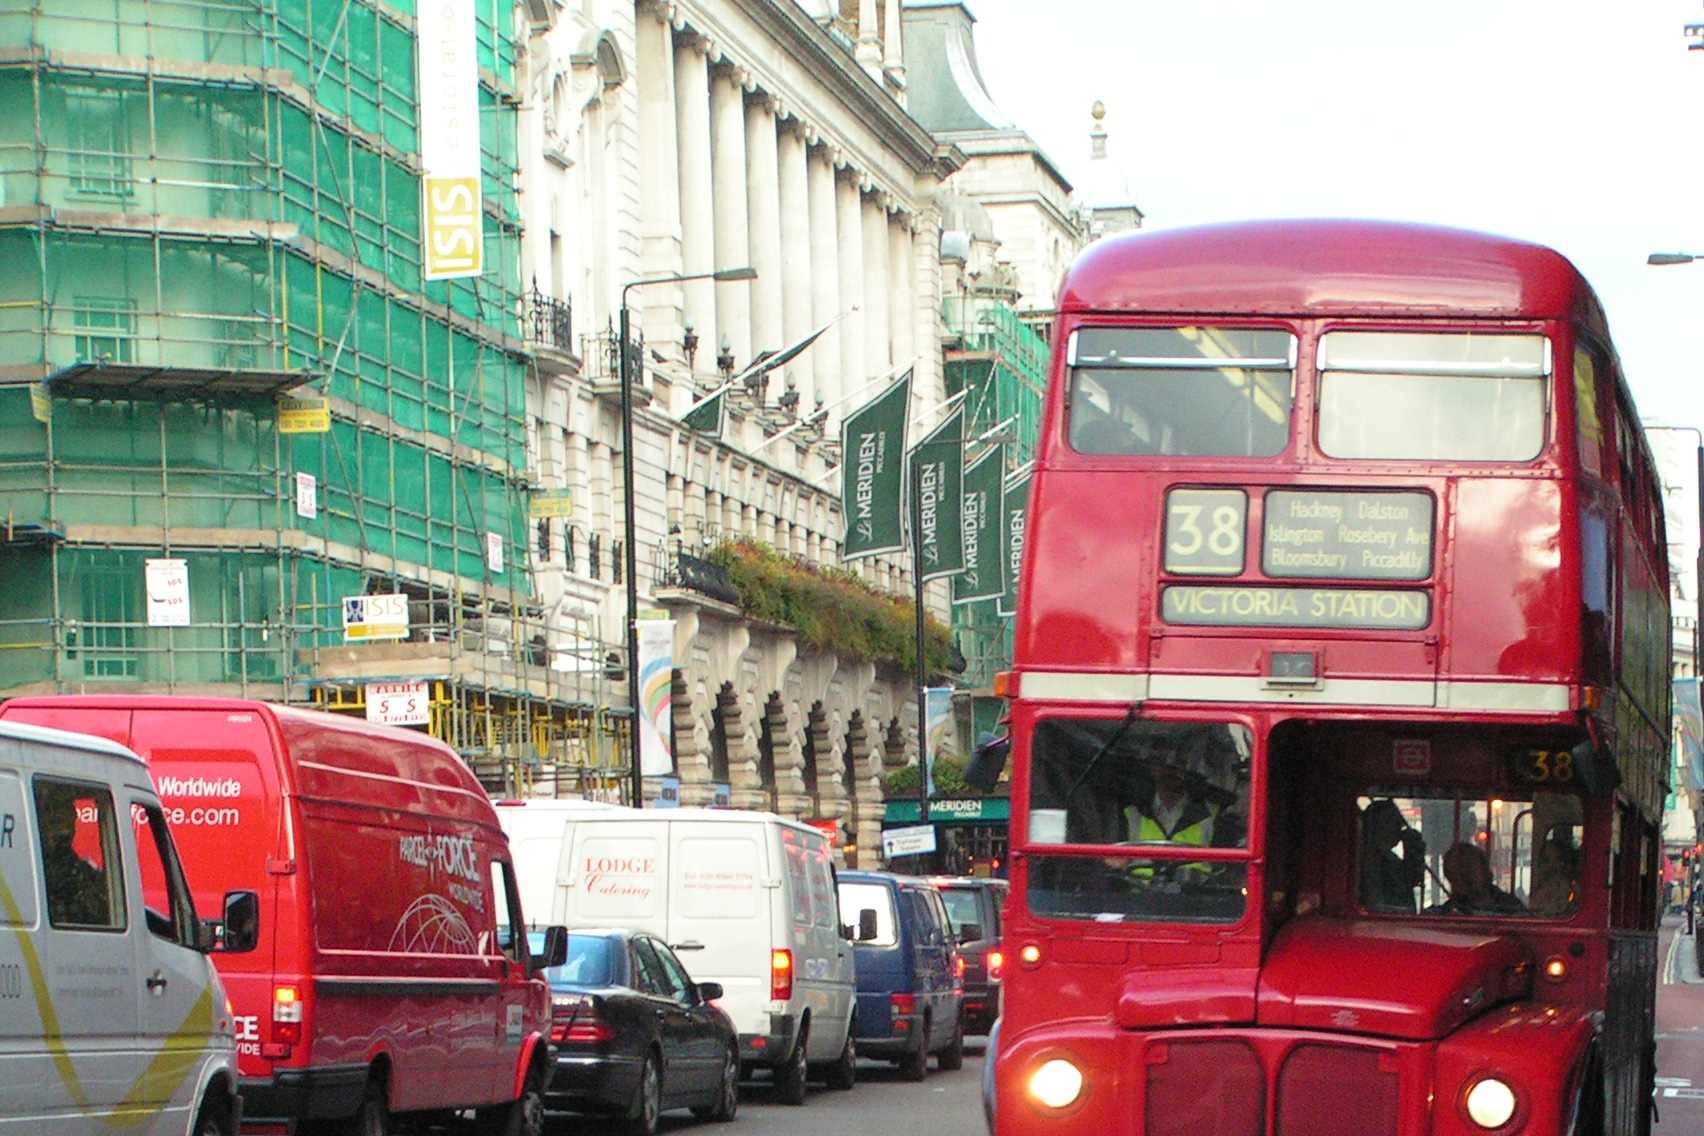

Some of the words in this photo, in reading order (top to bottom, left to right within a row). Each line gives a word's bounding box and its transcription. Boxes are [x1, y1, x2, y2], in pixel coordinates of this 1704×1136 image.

[432, 184, 475, 268] ISIS
[856, 432, 877, 518] MERIDIEN
[921, 463, 937, 545] MERIDIEN
[964, 491, 979, 568] MERIDIEN
[1170, 504, 1241, 556] 38
[1290, 500, 1343, 523] Hackney
[1358, 501, 1410, 520] Dalston
[1268, 524, 1324, 546] Islington
[1338, 525, 1398, 549] Rosebery
[1405, 529, 1430, 545] Ave
[1271, 548, 1347, 570] Bloomsbury
[1362, 550, 1424, 572] Piccadilly
[365, 597, 405, 617] ISIS
[1171, 591, 1299, 616] VICTORIA
[1310, 592, 1424, 619] STATION
[1527, 749, 1574, 783] 38
[157, 776, 241, 797] Worldwide
[930, 800, 982, 812] MERIDIEN
[399, 836, 428, 868] PARCEL
[437, 834, 481, 882] FORCE
[586, 858, 655, 874] LODGE
[585, 873, 651, 900] Catering
